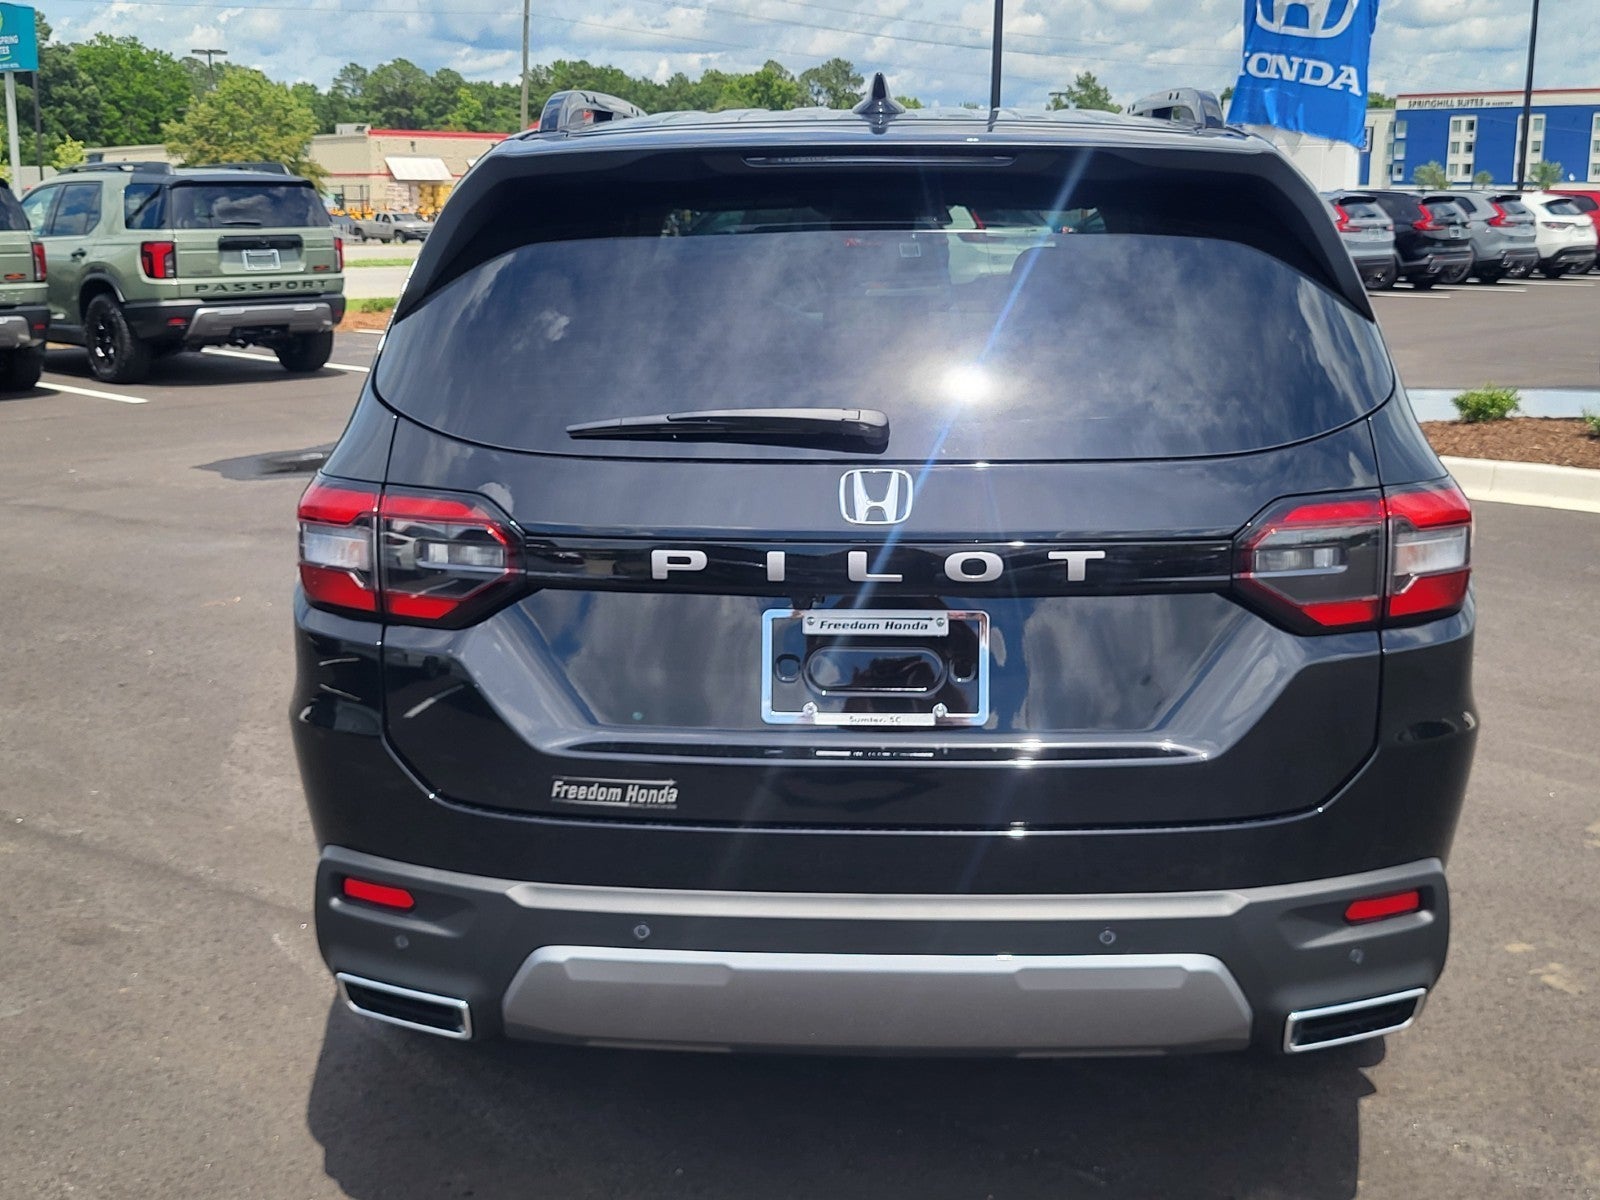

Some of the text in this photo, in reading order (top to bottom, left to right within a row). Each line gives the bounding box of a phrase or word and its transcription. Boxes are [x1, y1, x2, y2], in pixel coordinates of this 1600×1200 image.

[1239, 51, 1362, 97] ONDA
[1408, 99, 1455, 109] SPRINGHILL
[1457, 98, 1484, 108] SUITES
[194, 279, 328, 293] PASSPORT
[650, 549, 1107, 583] PILOT
[819, 620, 929, 631] Freedom Honda
[889, 716, 902, 725] SC
[551, 780, 678, 803] Freedom Honda
